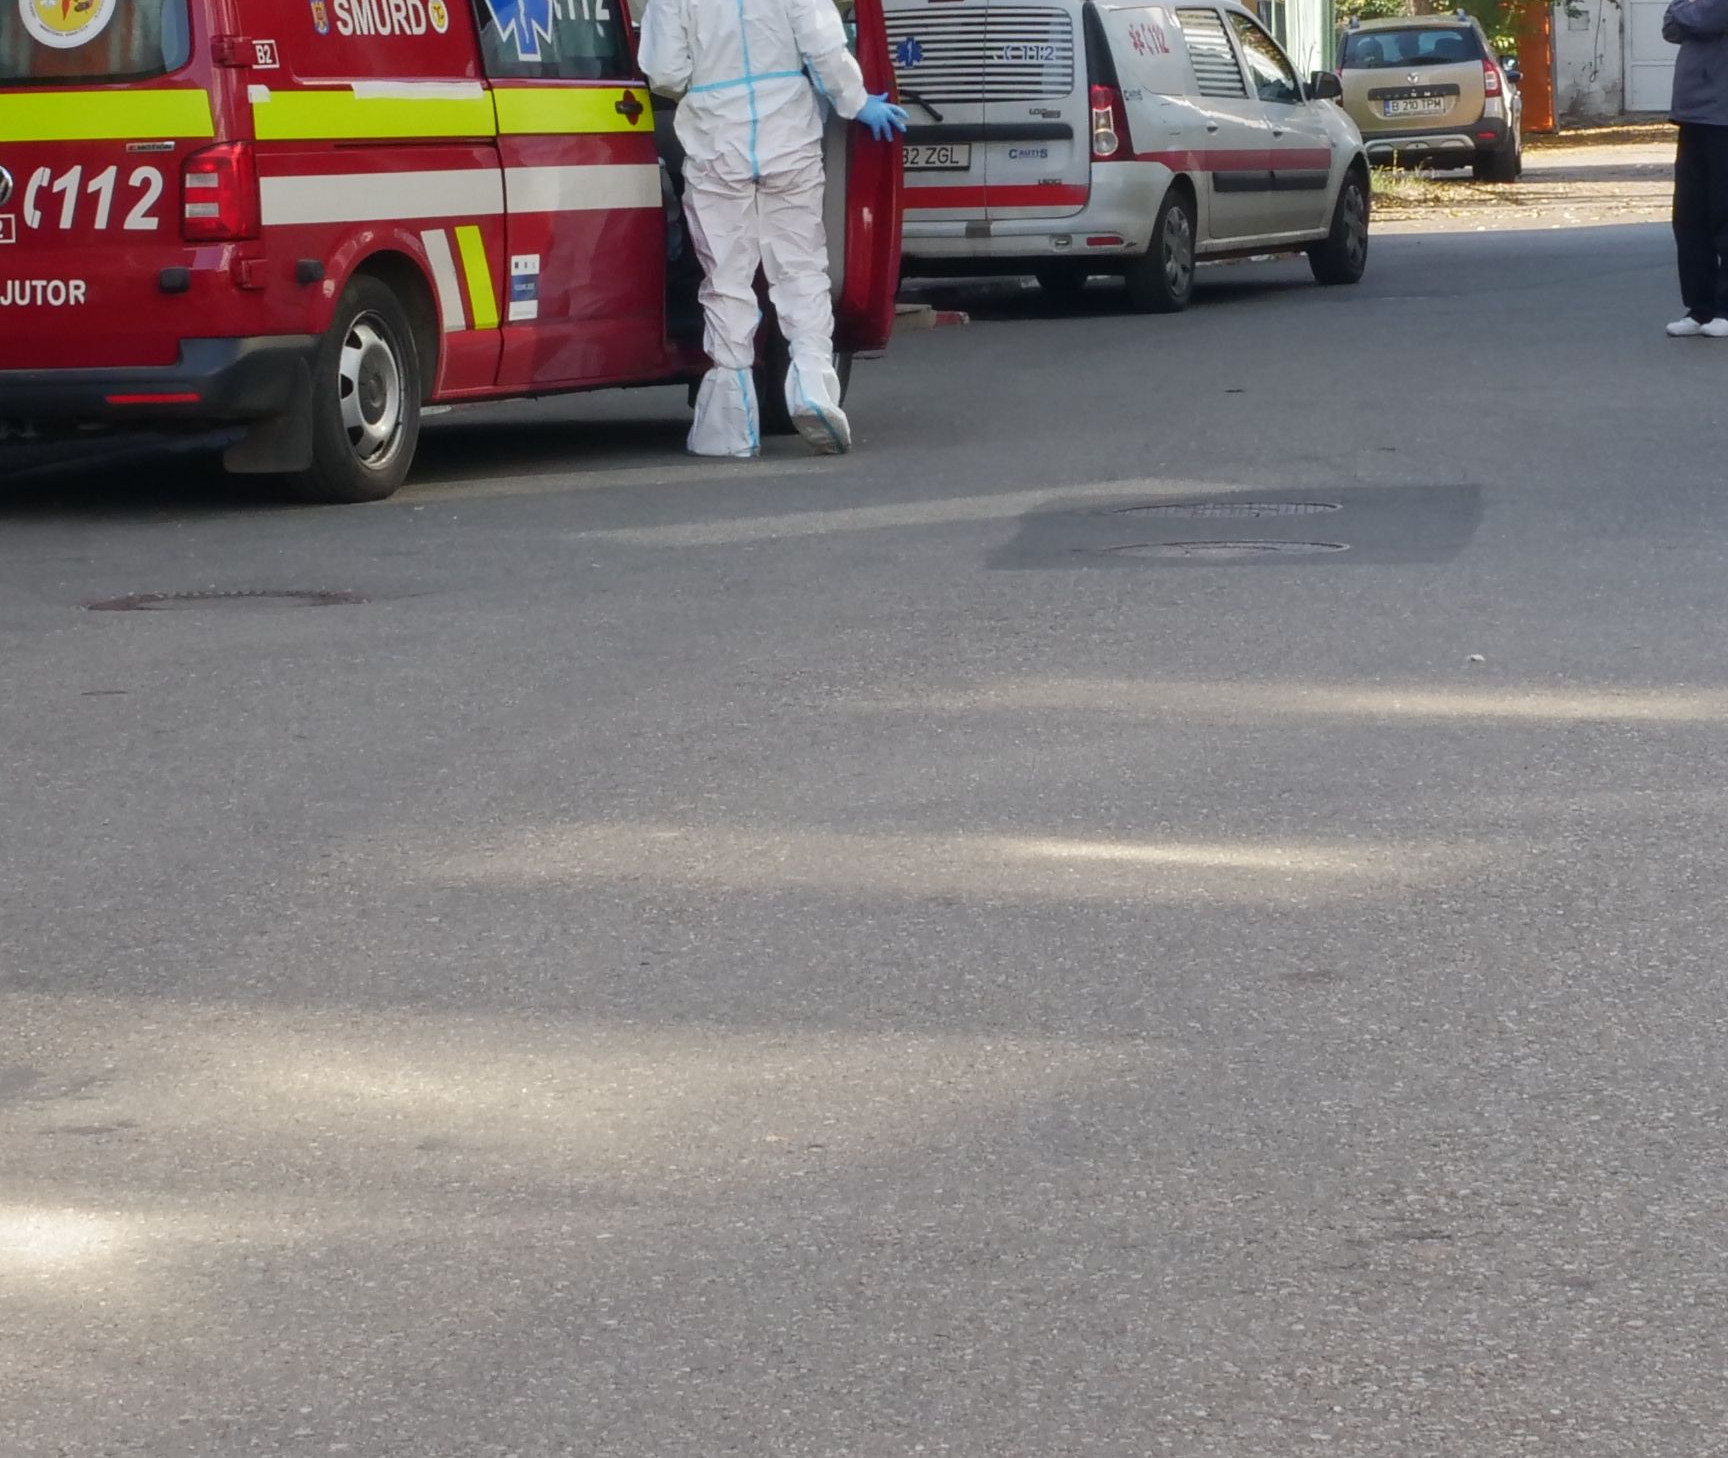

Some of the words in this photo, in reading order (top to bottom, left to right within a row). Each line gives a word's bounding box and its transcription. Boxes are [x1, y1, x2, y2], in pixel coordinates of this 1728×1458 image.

[256, 44, 273, 65] B2
[1022, 46, 1054, 61] 112
[925, 147, 959, 164] ZGL
[52, 165, 164, 230] 112
